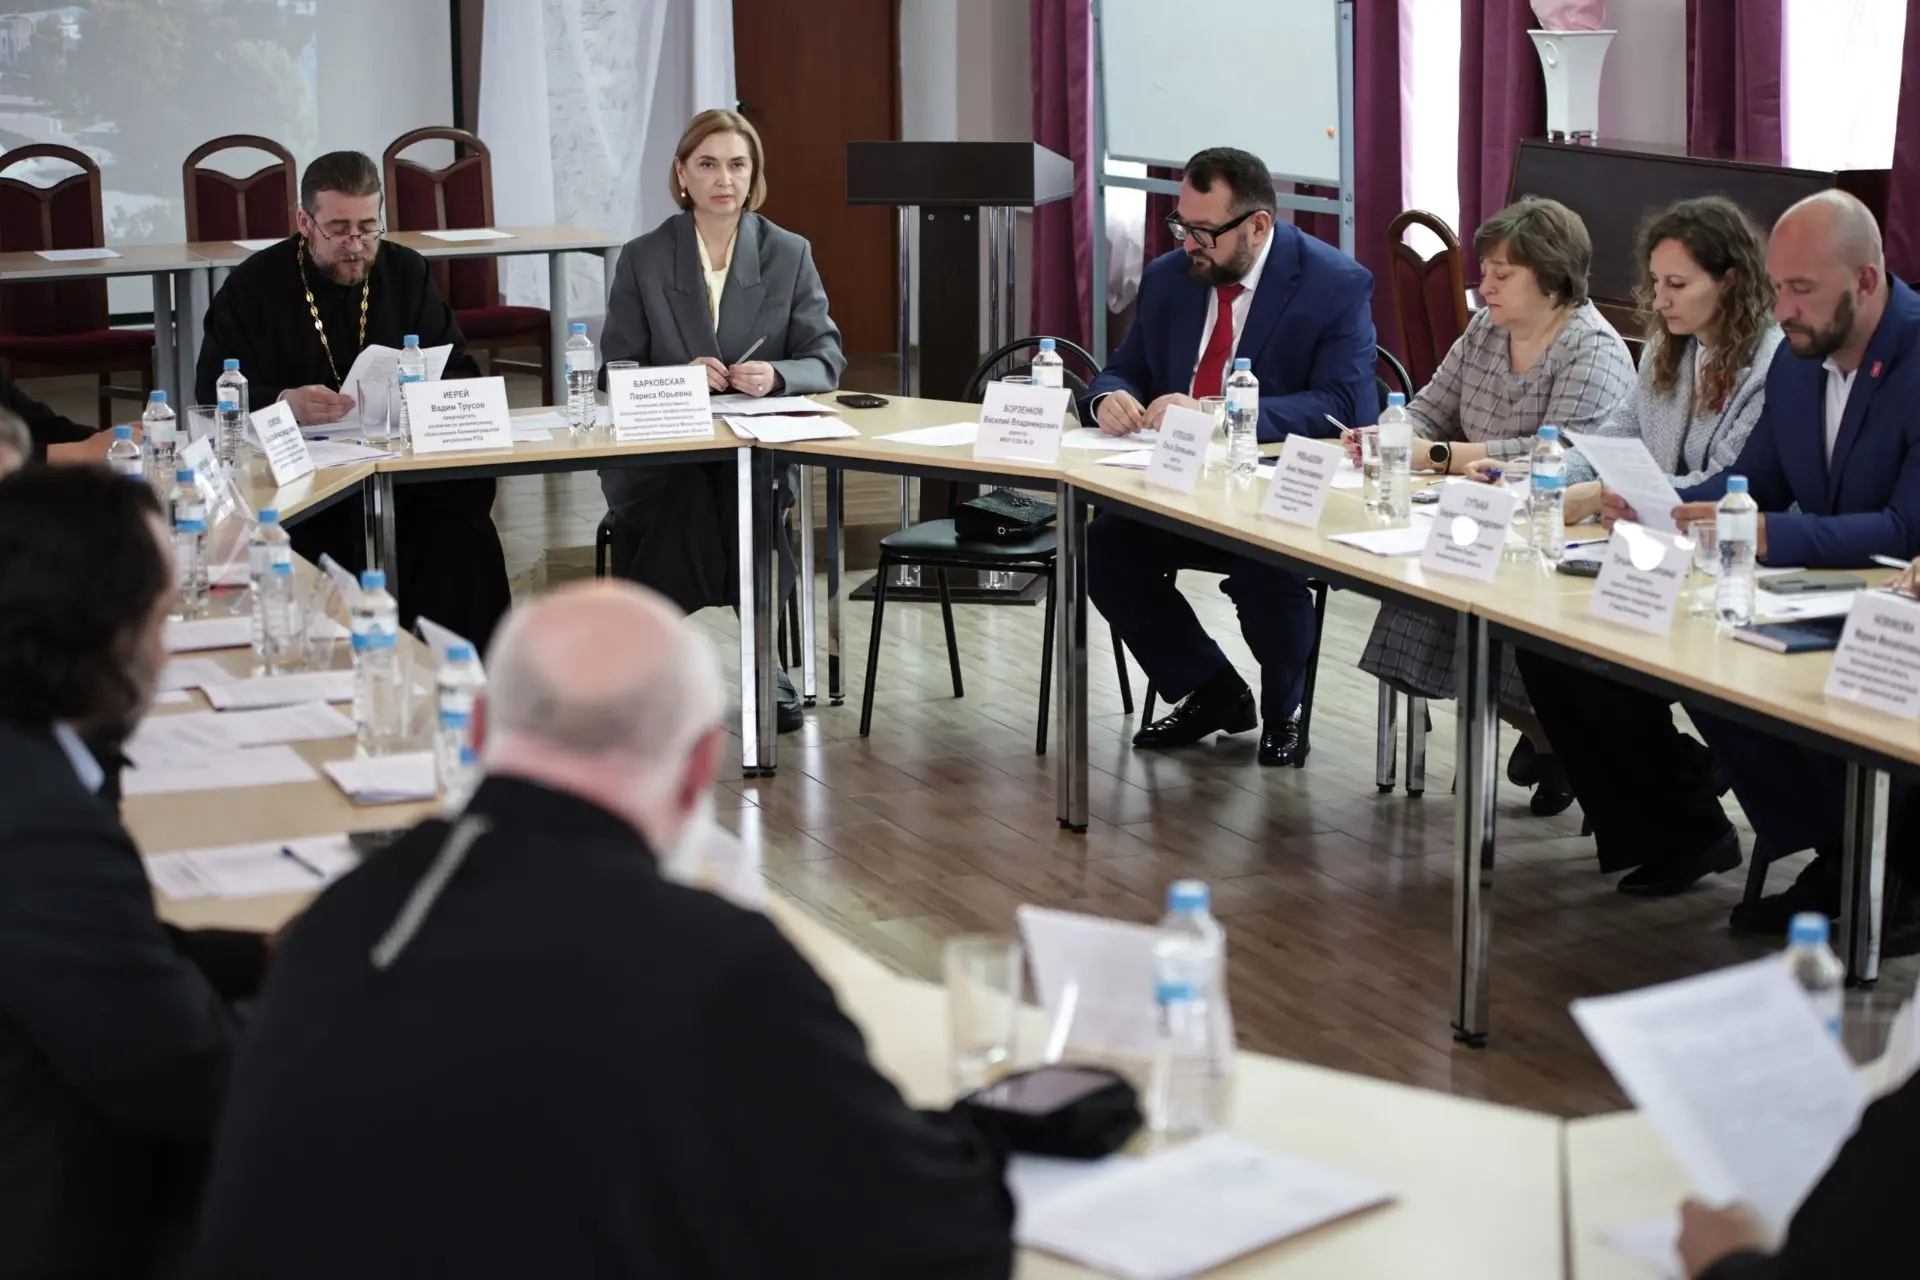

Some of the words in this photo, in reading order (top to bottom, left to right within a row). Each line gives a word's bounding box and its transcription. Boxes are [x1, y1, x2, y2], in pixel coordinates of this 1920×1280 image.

[633, 378, 686, 388] БАРКОВСКАЯ
[443, 388, 470, 399] ИЕРЕЙ
[629, 392, 657, 401] Лариса
[658, 390, 693, 399] Юрьевна
[431, 404, 457, 413] Вадим
[457, 402, 486, 412] Трусов
[1003, 404, 1044, 416] БОРЗЕНКОВ
[983, 415, 1010, 425] Василий
[1011, 417, 1060, 429] Владимирович
